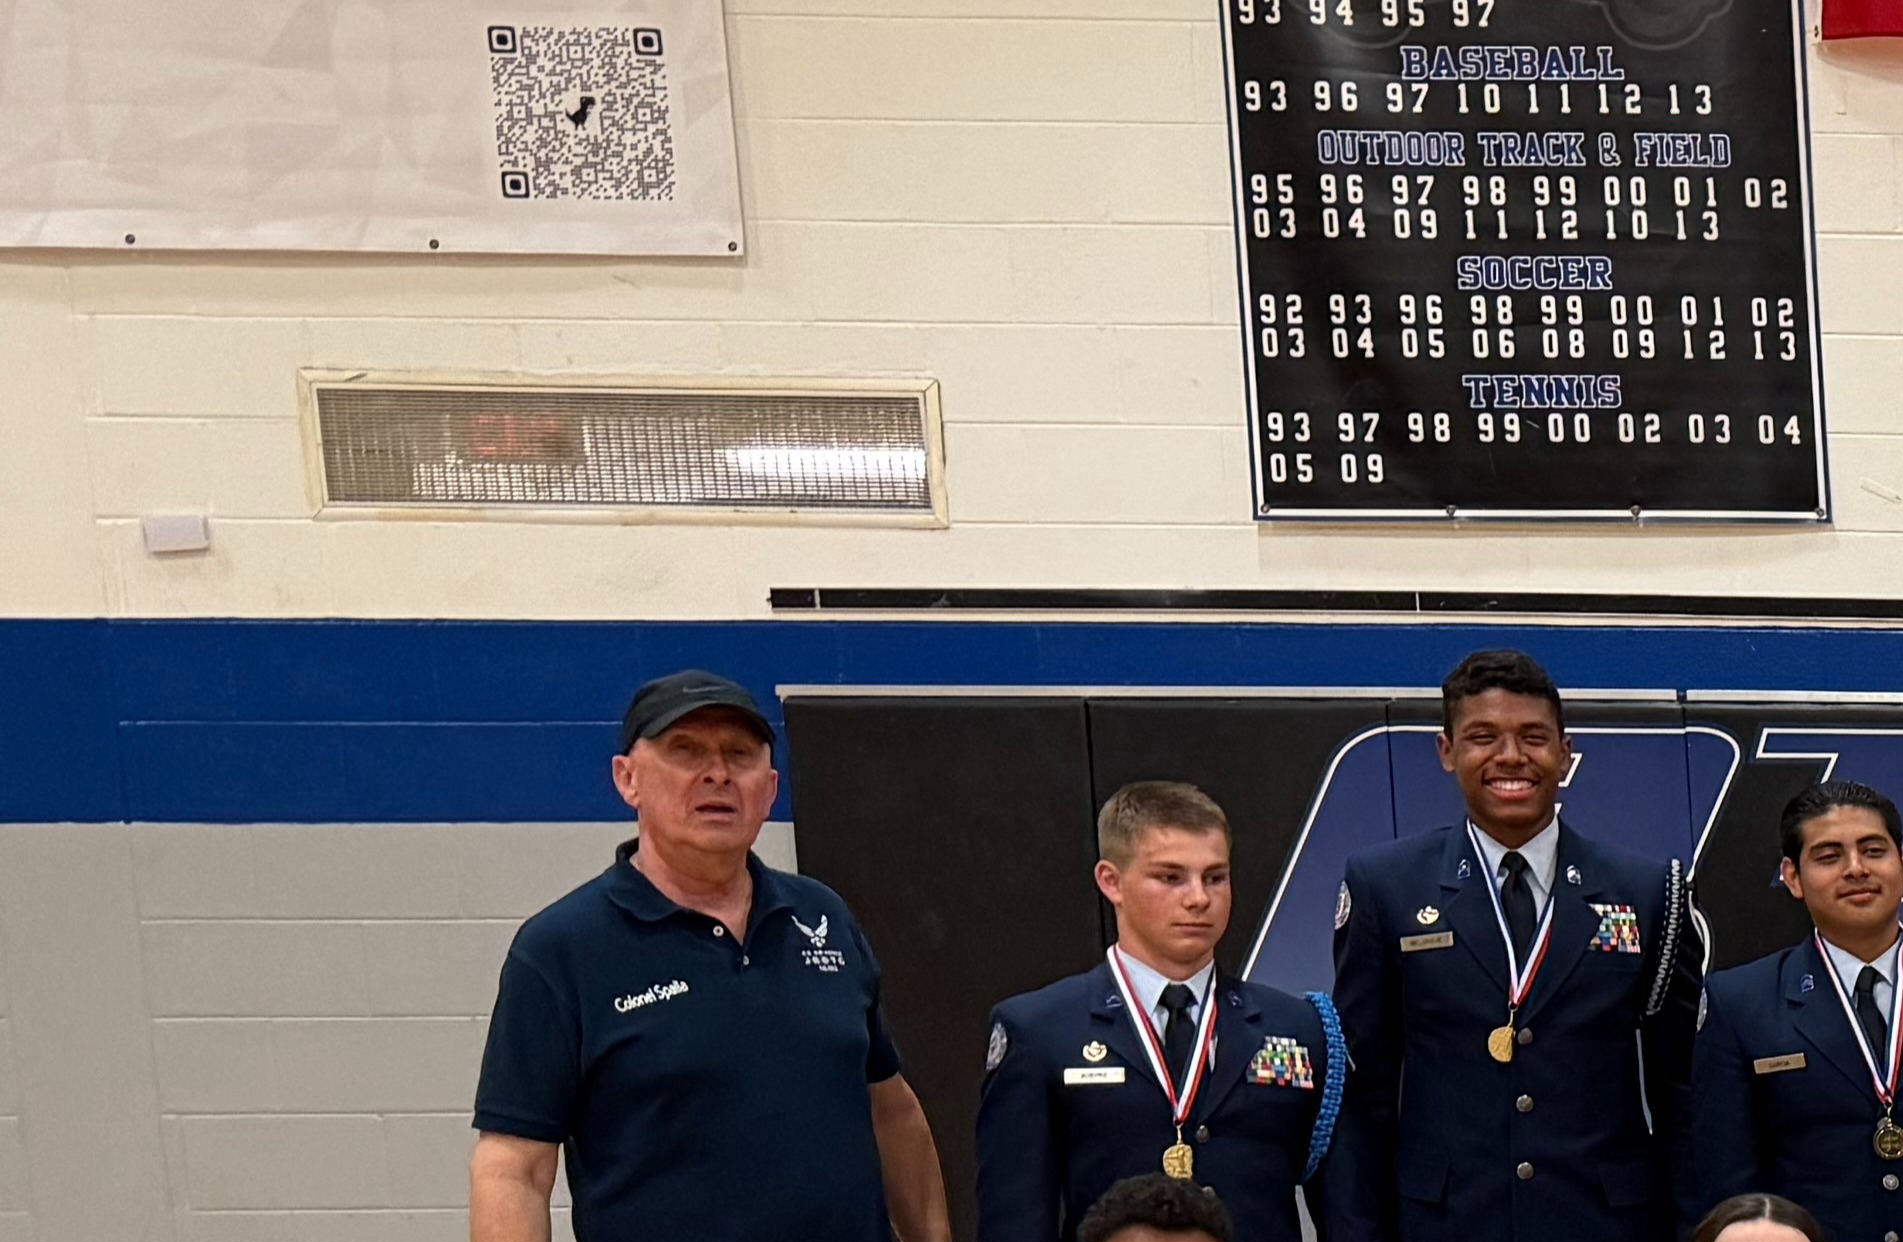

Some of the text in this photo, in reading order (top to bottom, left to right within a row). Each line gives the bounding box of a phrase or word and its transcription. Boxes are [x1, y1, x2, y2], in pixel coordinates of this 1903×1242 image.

[1400, 45, 1625, 81] BASEBALL
[1244, 80, 1712, 115] 93 96 97 10 11 12 13
[1317, 129, 1731, 168] OUTDOOR TRACK & FIELD
[1251, 173, 1788, 209] 95 96 97 98 99 00 01 02
[1253, 207, 1719, 241] 03 04 09 11 12 10 13
[1457, 255, 1613, 290] SOCCER
[1259, 294, 1794, 327] 92 93 96 98 99 00 01 02
[1261, 327, 1796, 361] 03 04 05 06 08 09 12 13
[1462, 374, 1622, 409] TENNIS
[1267, 412, 1801, 445] 93 97 98 99 00 02 03 04
[1270, 453, 1384, 483] 05 09
[614, 987, 658, 1013] Colonel
